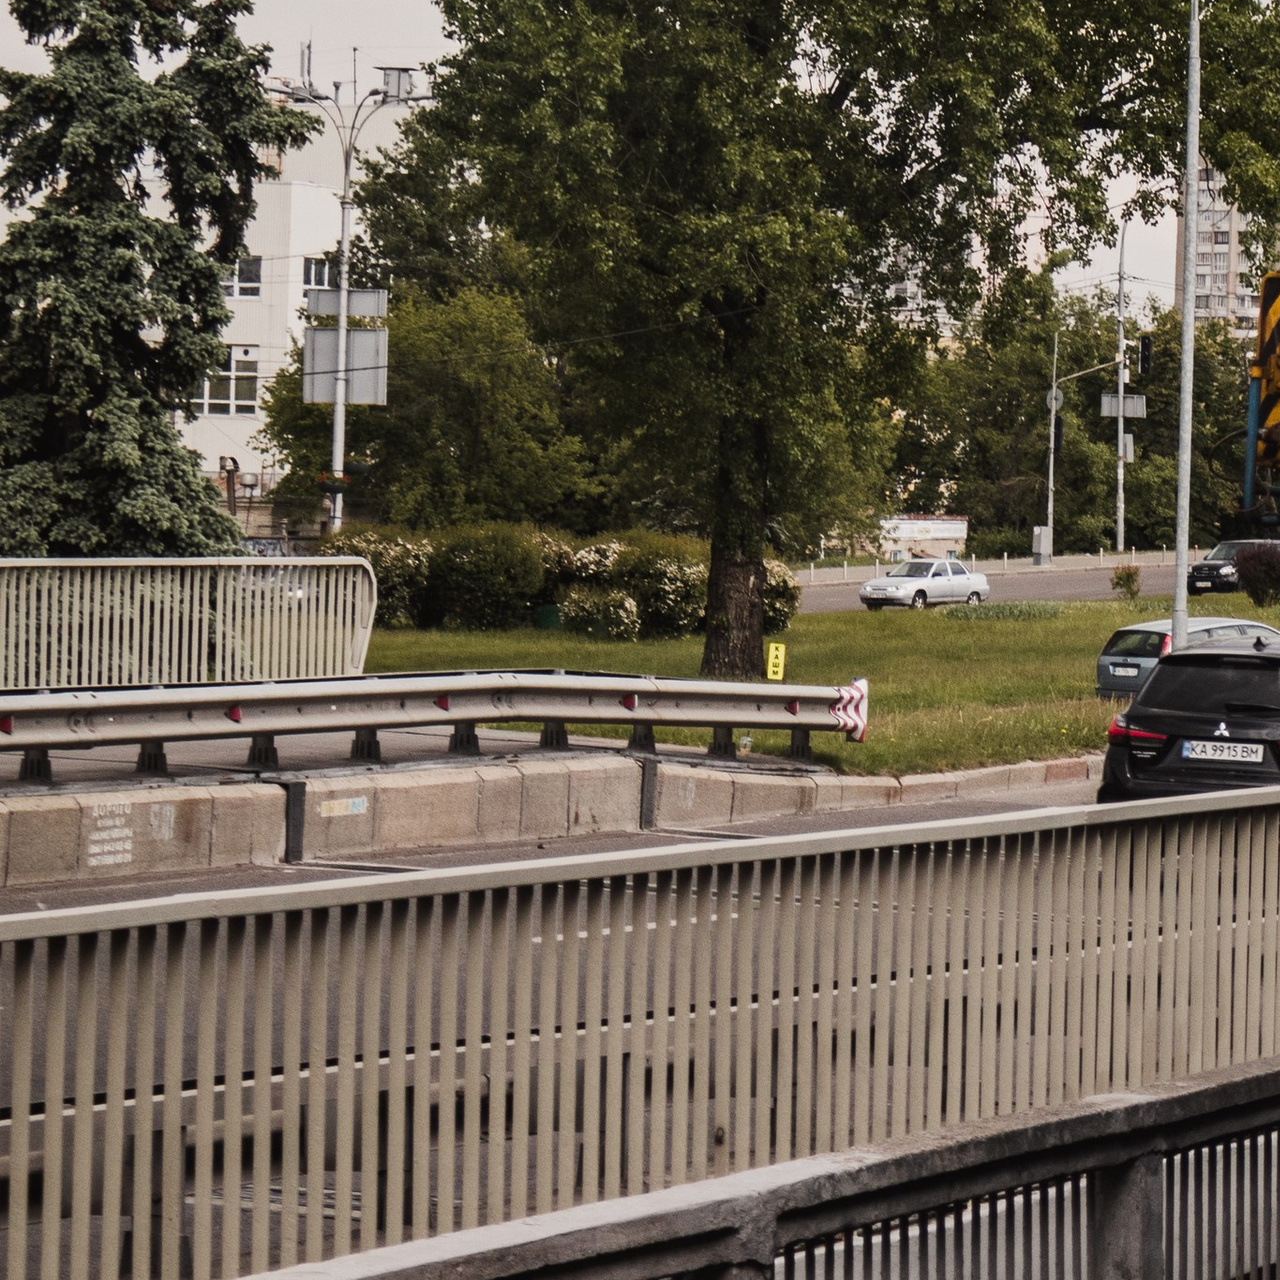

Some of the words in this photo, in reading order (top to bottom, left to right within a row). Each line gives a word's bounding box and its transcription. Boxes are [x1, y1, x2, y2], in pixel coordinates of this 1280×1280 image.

[1191, 743, 1207, 756] KA
[1211, 744, 1238, 758] 9915
[1241, 746, 1259, 759] BM
